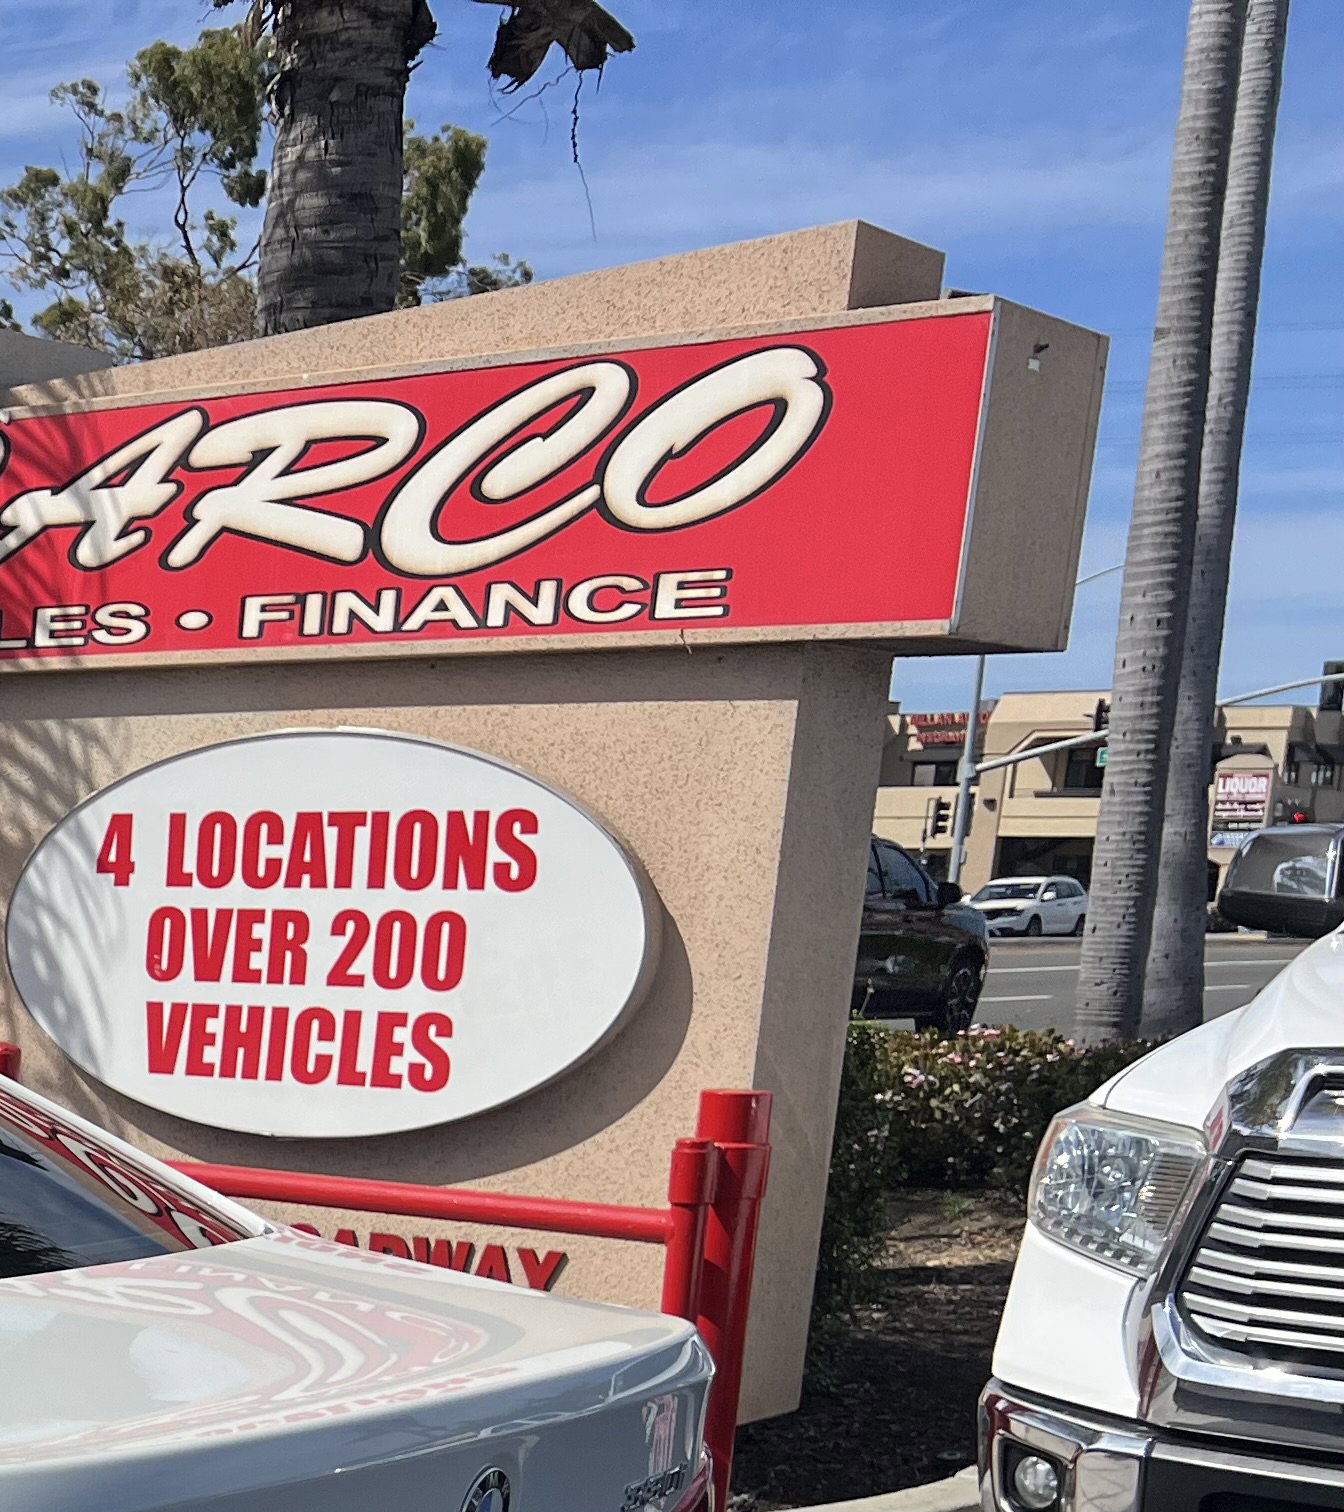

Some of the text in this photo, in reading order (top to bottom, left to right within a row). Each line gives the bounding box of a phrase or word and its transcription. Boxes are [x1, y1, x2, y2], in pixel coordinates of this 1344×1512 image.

[238, 567, 734, 640] FINANCE
[1217, 776, 1268, 794] LIQUOR
[96, 808, 539, 892] 4 LOCATIONS
[146, 906, 467, 992] OVER 200
[146, 1001, 453, 1093] VEHICLES
